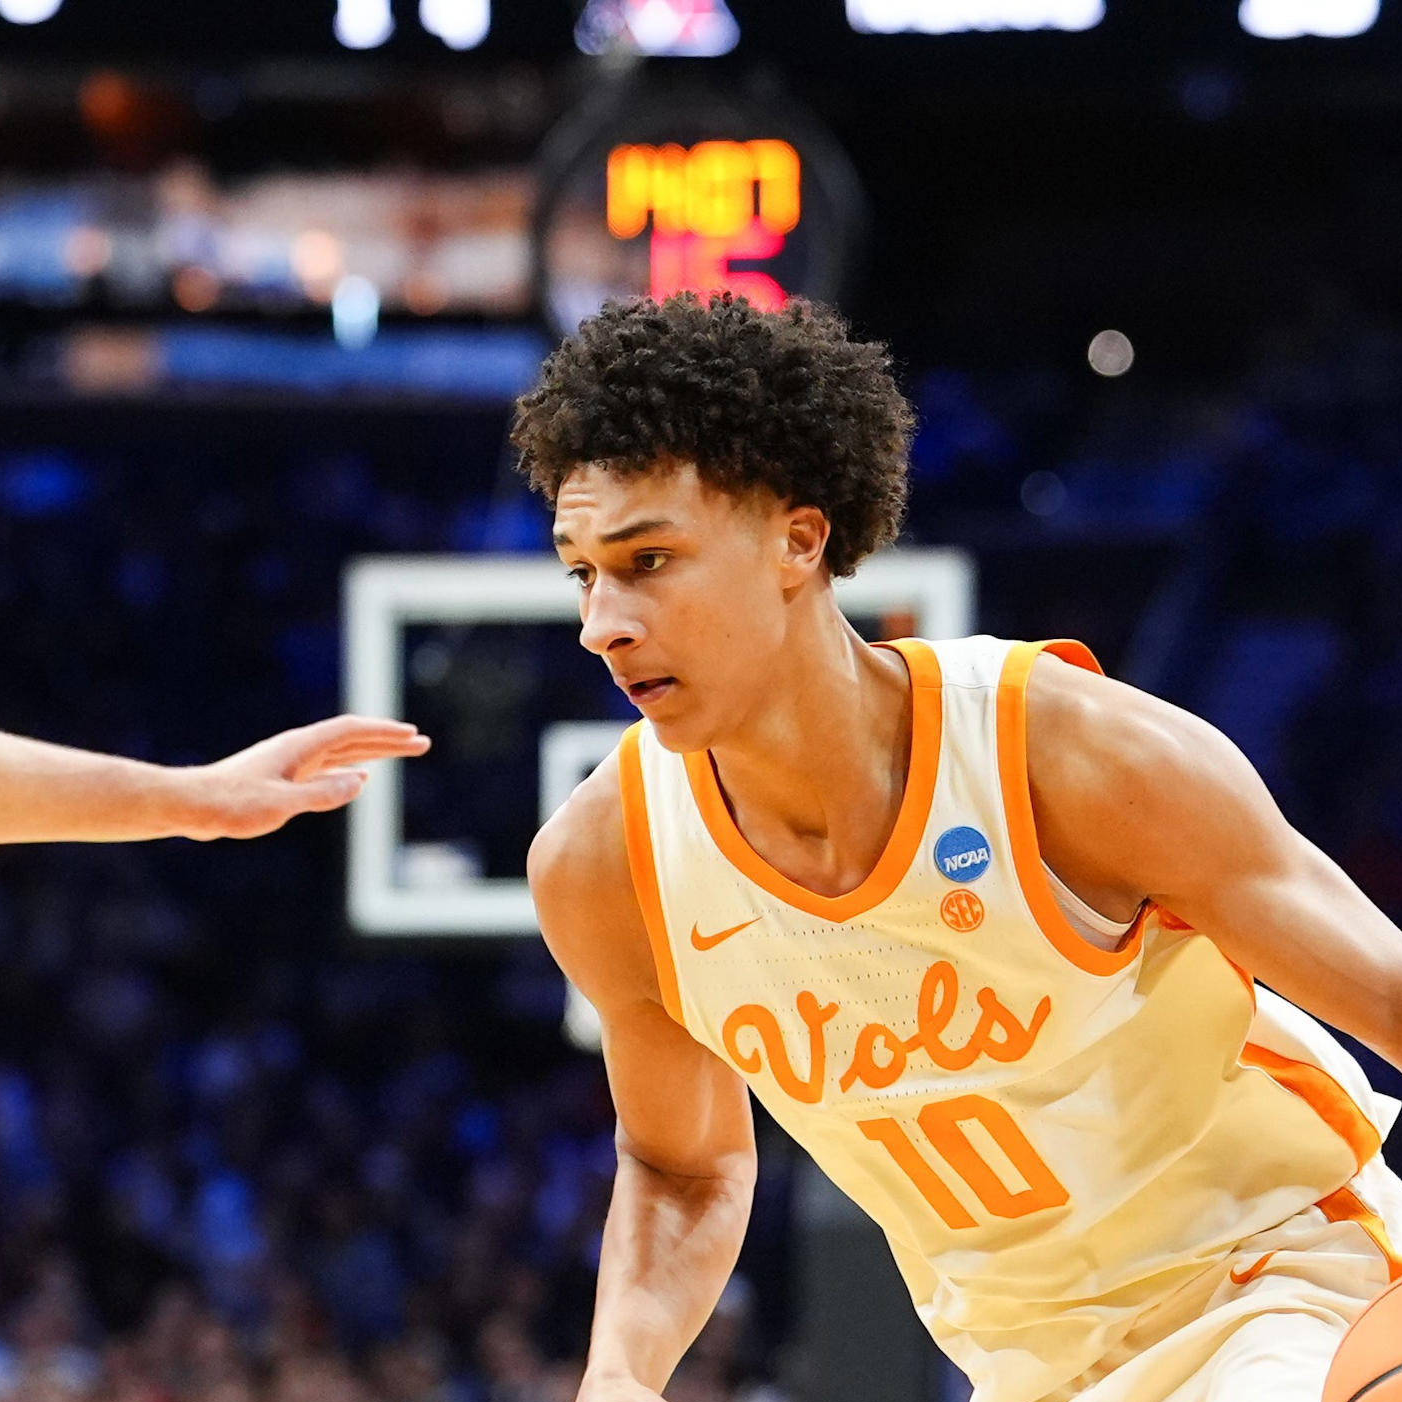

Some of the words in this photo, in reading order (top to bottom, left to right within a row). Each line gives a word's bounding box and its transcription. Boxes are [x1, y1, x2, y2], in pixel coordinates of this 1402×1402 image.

[944, 847, 989, 872] NCAA
[944, 893, 981, 928] SEC
[722, 960, 1051, 1103] Vols
[856, 1094, 1070, 1229] 10
